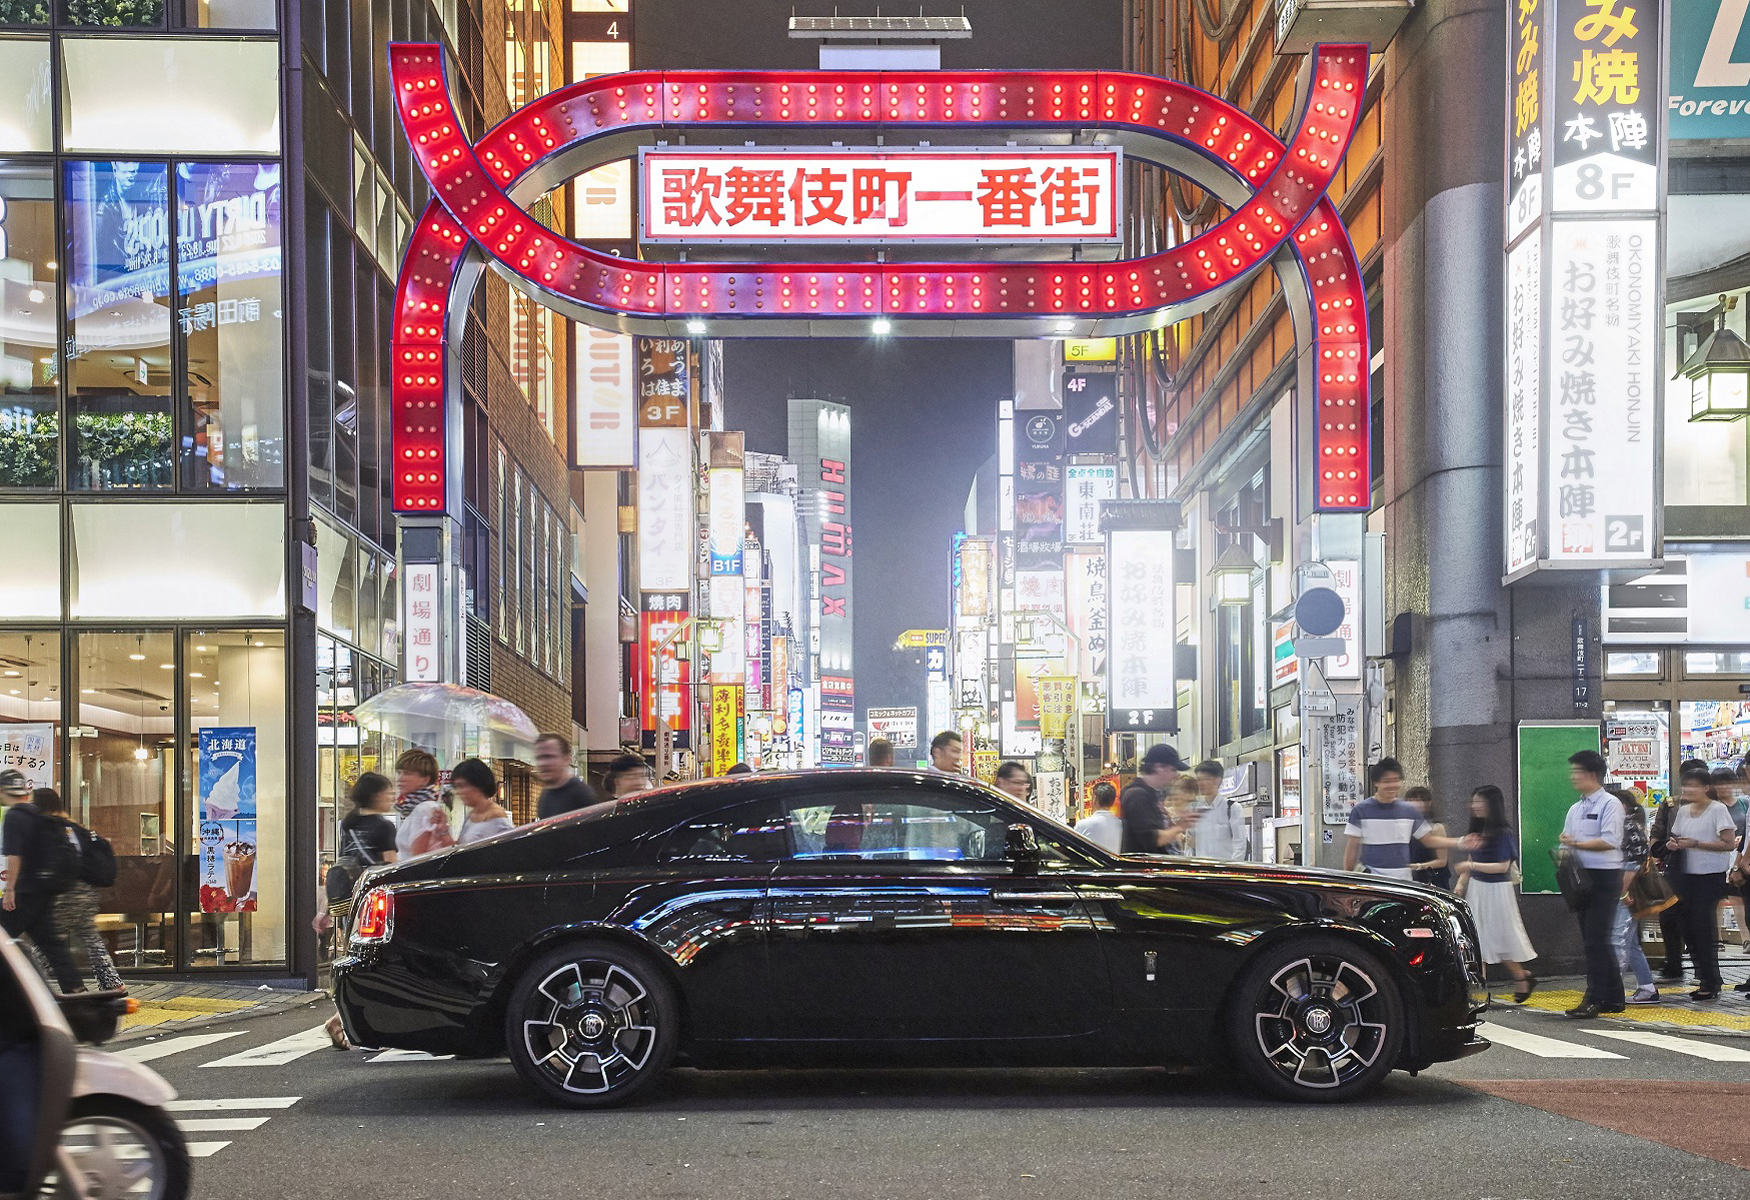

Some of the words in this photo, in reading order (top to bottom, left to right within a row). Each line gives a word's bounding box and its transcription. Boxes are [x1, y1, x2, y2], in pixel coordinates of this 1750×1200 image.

[1563, 109, 1648, 152] 本陣
[661, 165, 1101, 228] 歌舞伎町一番街
[1574, 162, 1636, 201] 8F
[1517, 184, 1537, 225] 8F
[1605, 234, 1621, 327] 歌舞伎町名物
[1627, 234, 1643, 366] OKONOMIYAKI
[1071, 345, 1089, 357] 5F
[1067, 378, 1087, 392] 4F
[1560, 260, 1598, 519] お好み焼き本陣
[647, 406, 680, 420] 3F
[1512, 283, 1524, 534] お好み焼き本陣
[1627, 372, 1641, 443] HONJIN
[1067, 468, 1115, 478] 全卓全自動
[645, 473, 669, 557] バンタイ
[1608, 520, 1643, 547] 2F
[713, 560, 740, 572] B1F
[649, 594, 682, 611] 焼肉
[412, 572, 432, 673] 劇場通り
[1576, 687, 1587, 697] 17
[1128, 709, 1155, 726] 2F
[0, 743, 20, 752] 日は
[207, 738, 247, 751] 北海道
[1336, 713, 1348, 804] 防犯カメラ作動中
[0, 755, 46, 771] にする?
